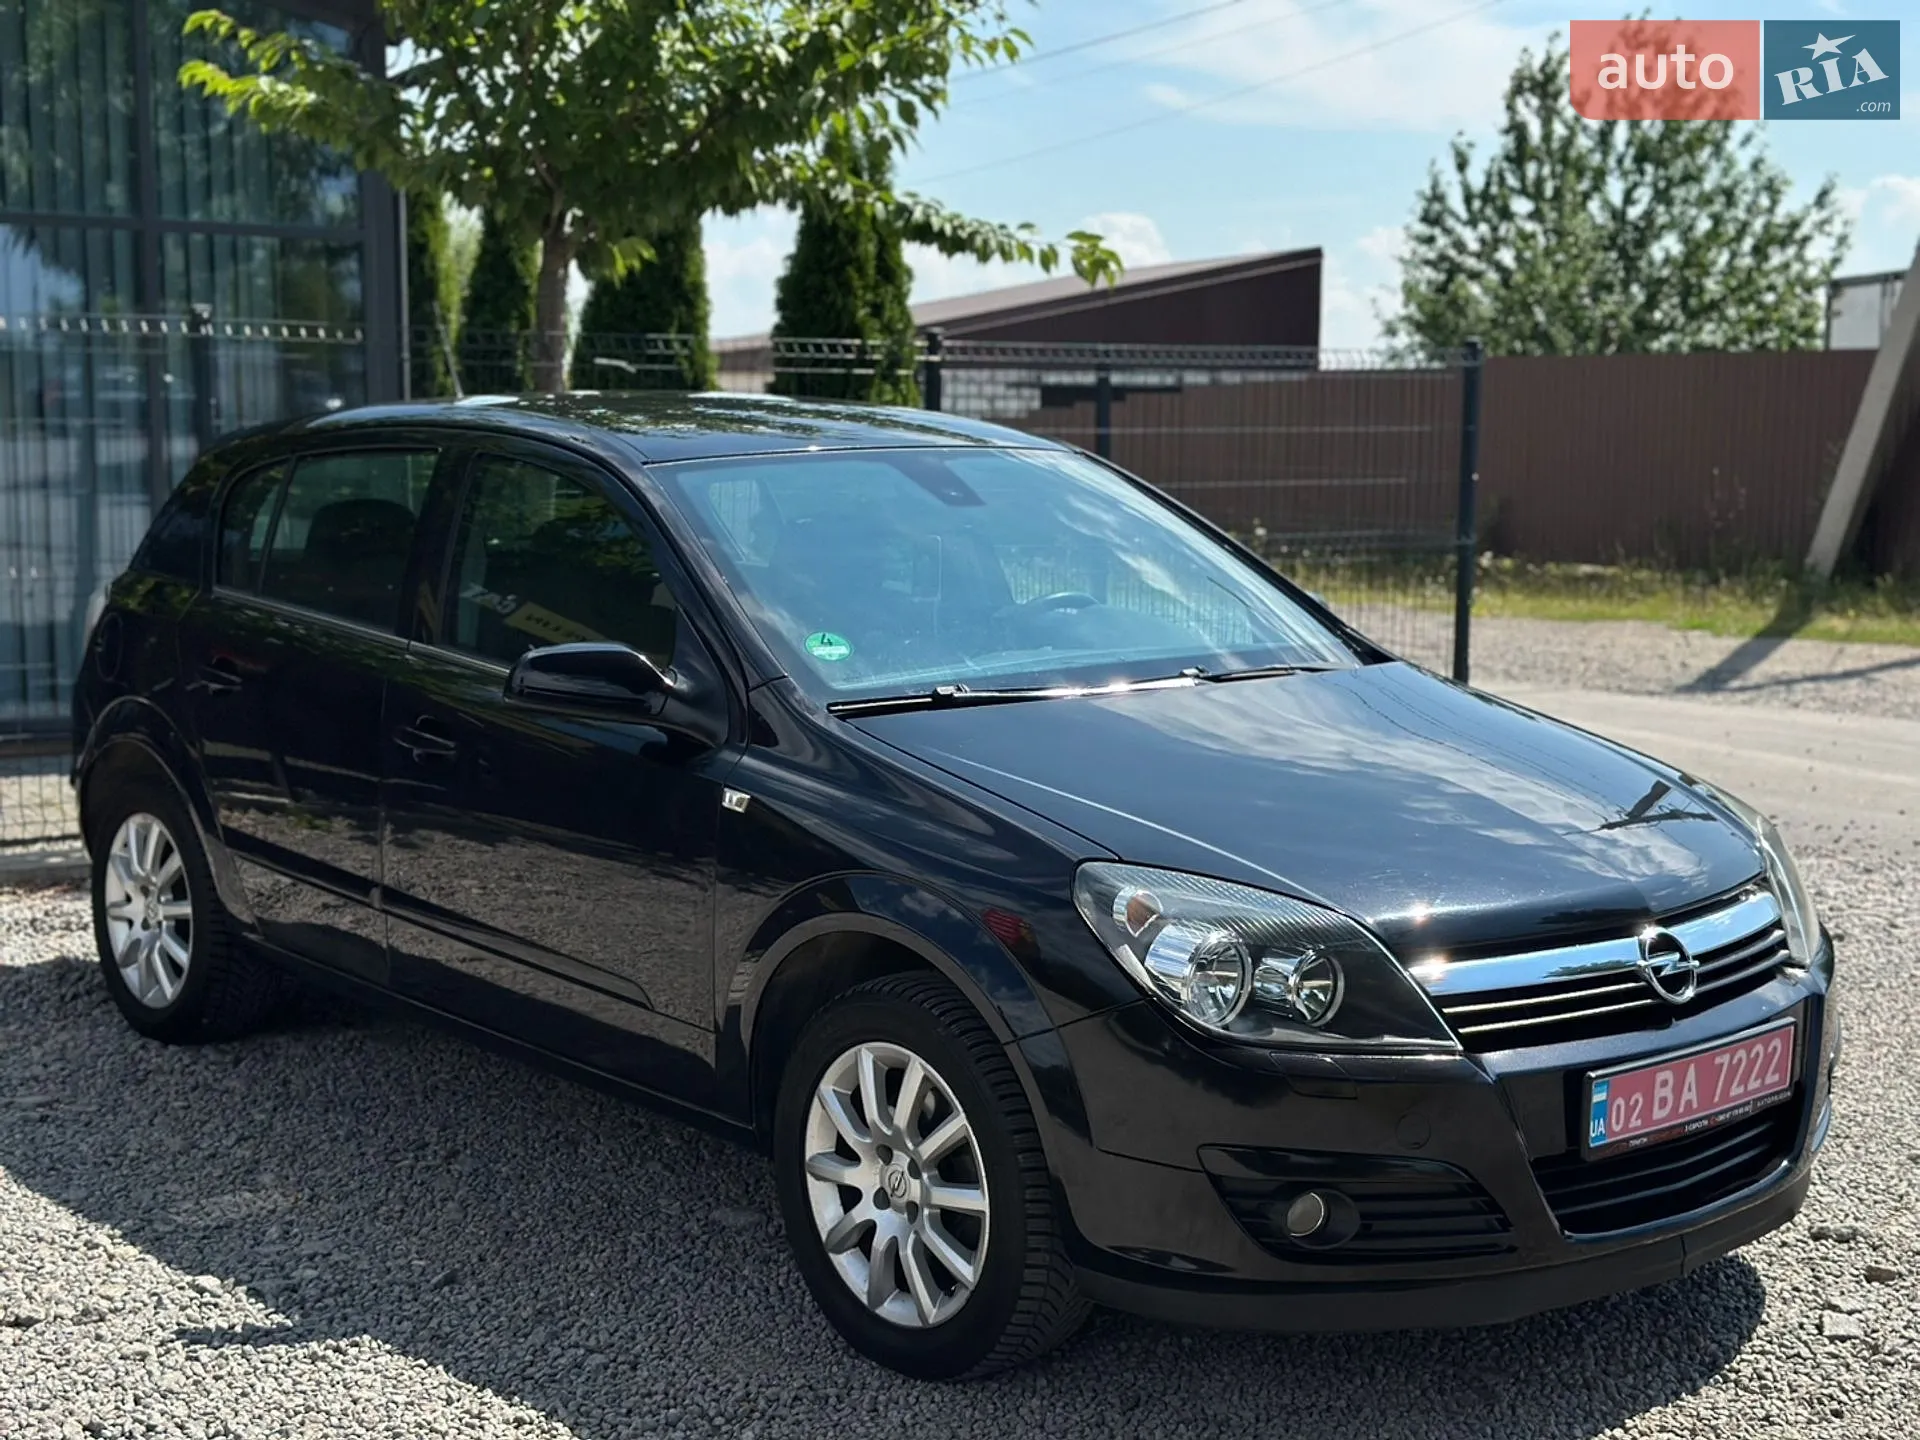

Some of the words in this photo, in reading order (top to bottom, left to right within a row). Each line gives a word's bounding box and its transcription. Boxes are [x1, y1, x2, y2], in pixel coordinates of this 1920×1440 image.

[820, 633, 833, 646] 4
[1611, 1092, 1643, 1132] 02
[1652, 1063, 1698, 1120] BA
[1713, 1037, 1782, 1103] 7222
[1590, 1118, 1606, 1137] UA
